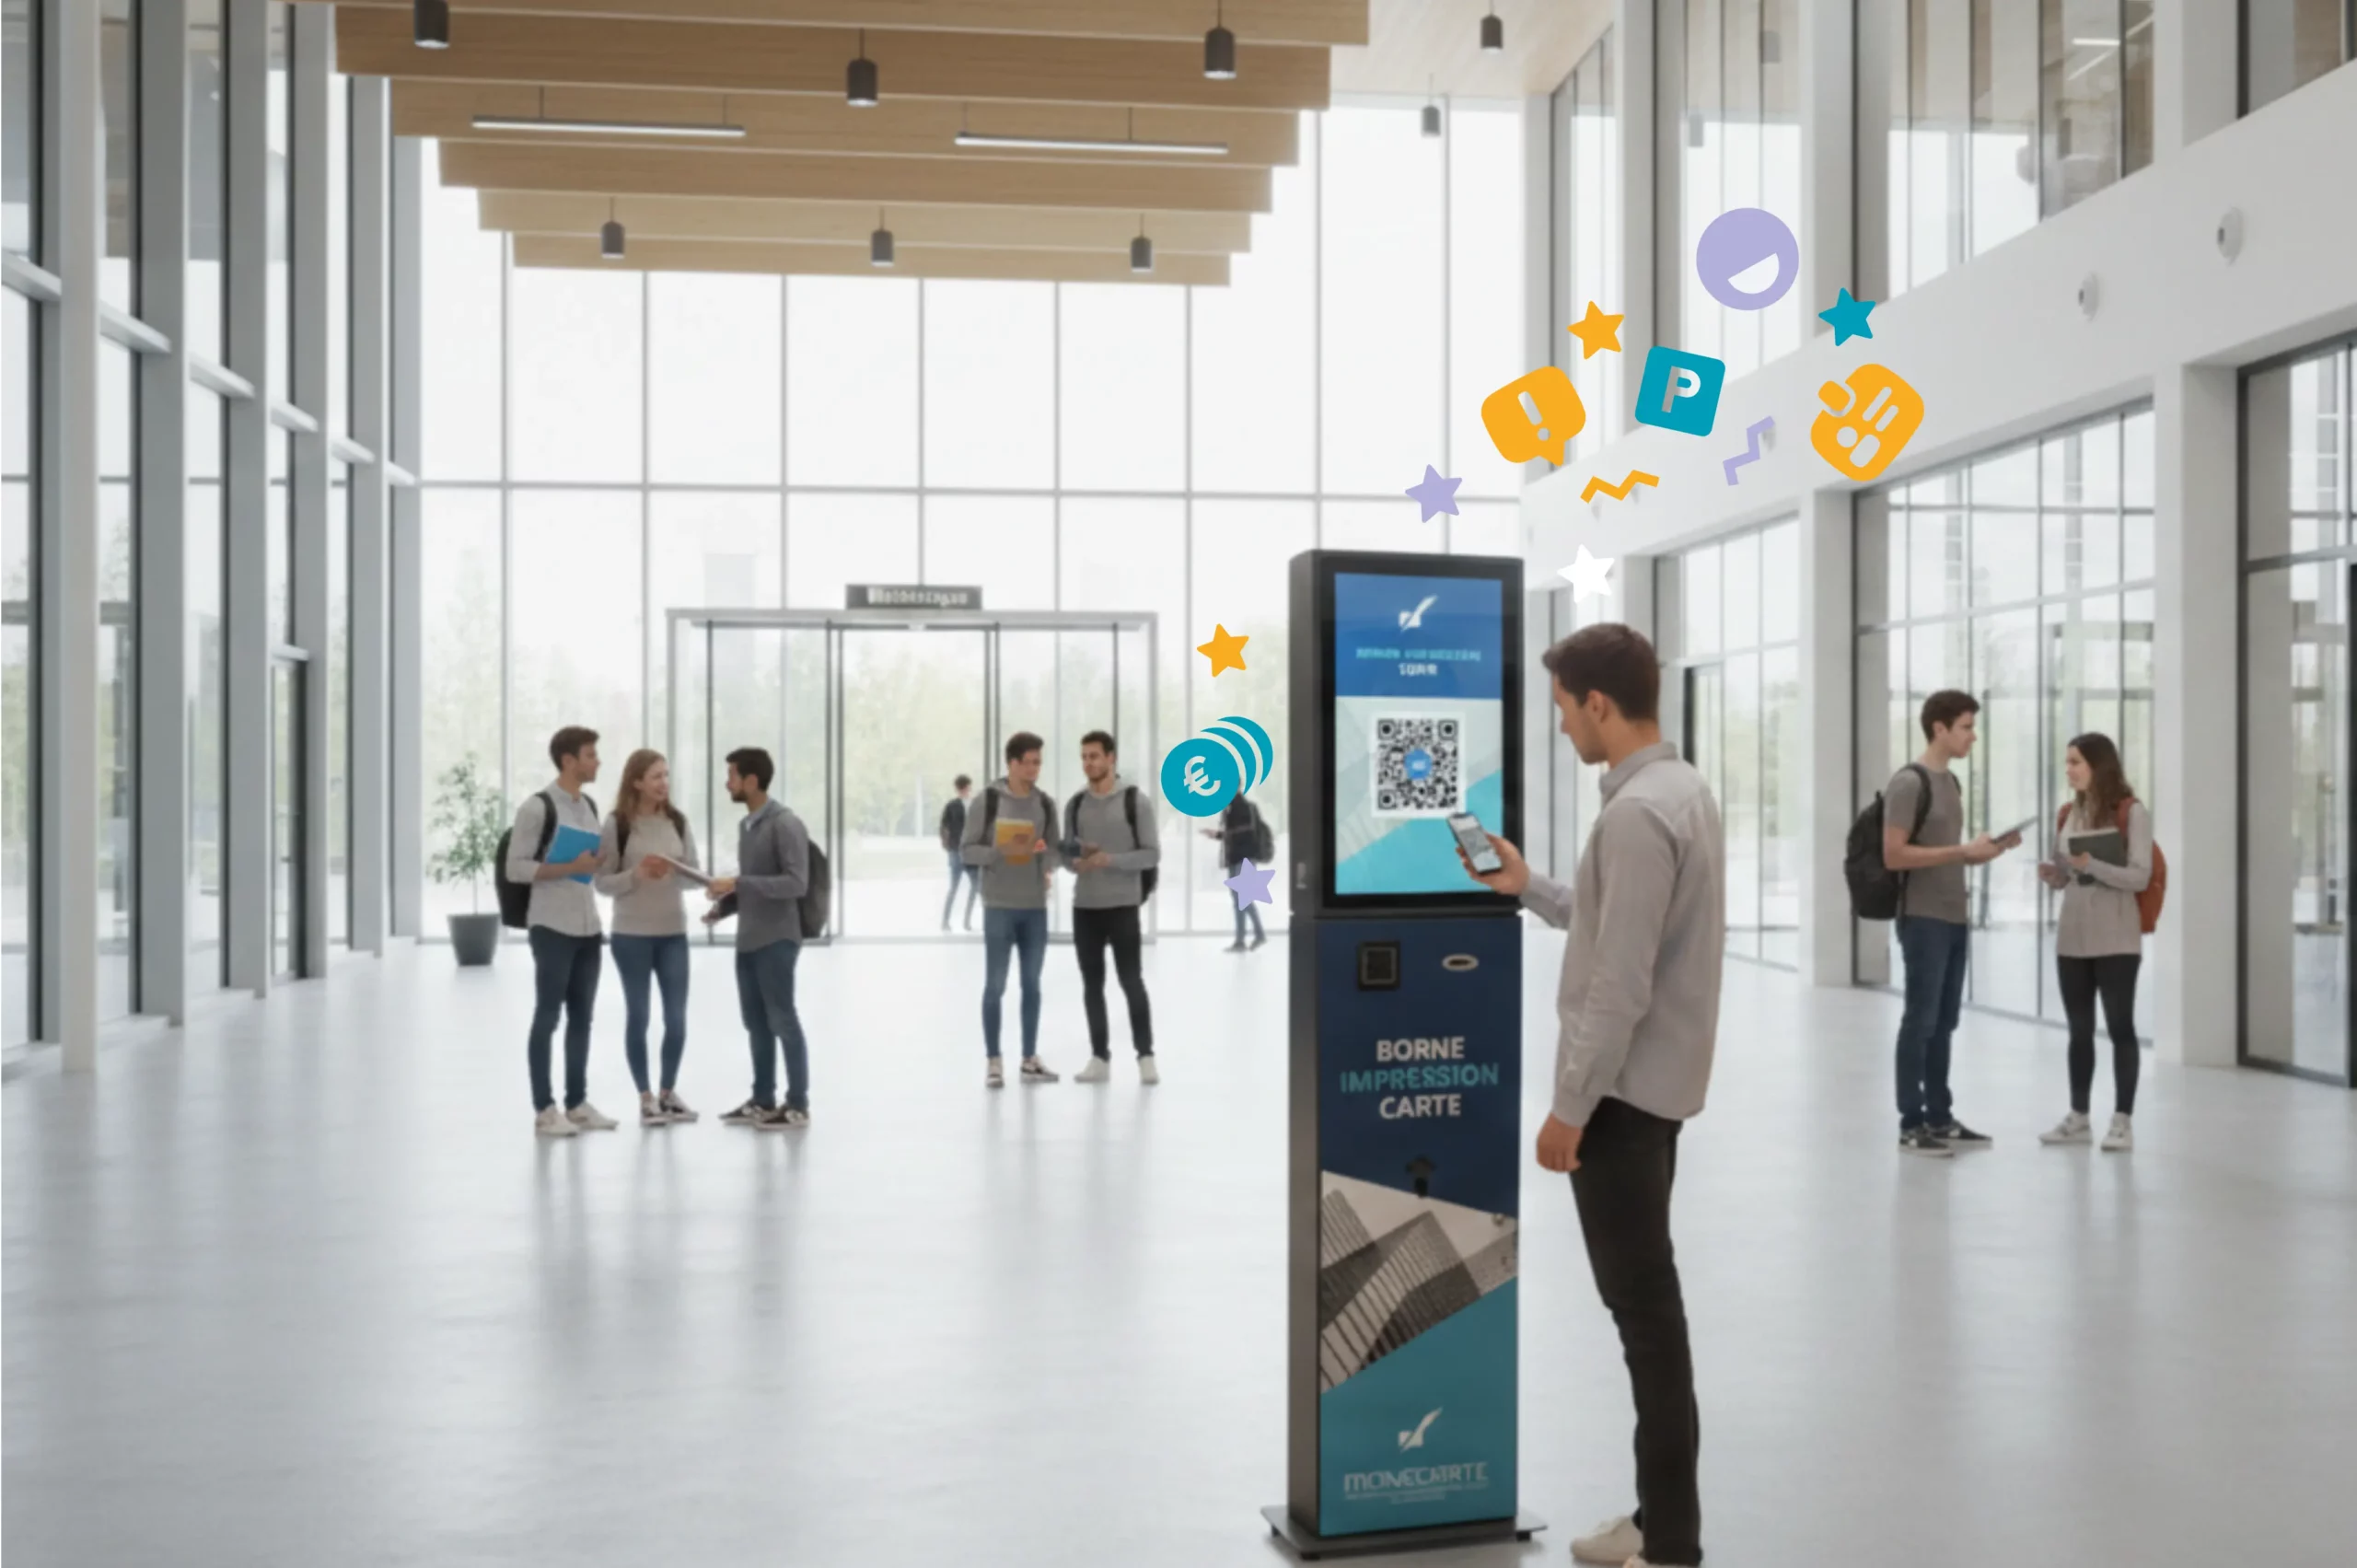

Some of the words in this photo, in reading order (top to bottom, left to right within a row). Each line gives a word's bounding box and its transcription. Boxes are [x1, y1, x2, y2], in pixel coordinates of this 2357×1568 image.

[1376, 1036, 1466, 1062] BORNE
[1340, 1063, 1500, 1094] IMPRESSION
[1378, 1093, 1462, 1120] CARTE
